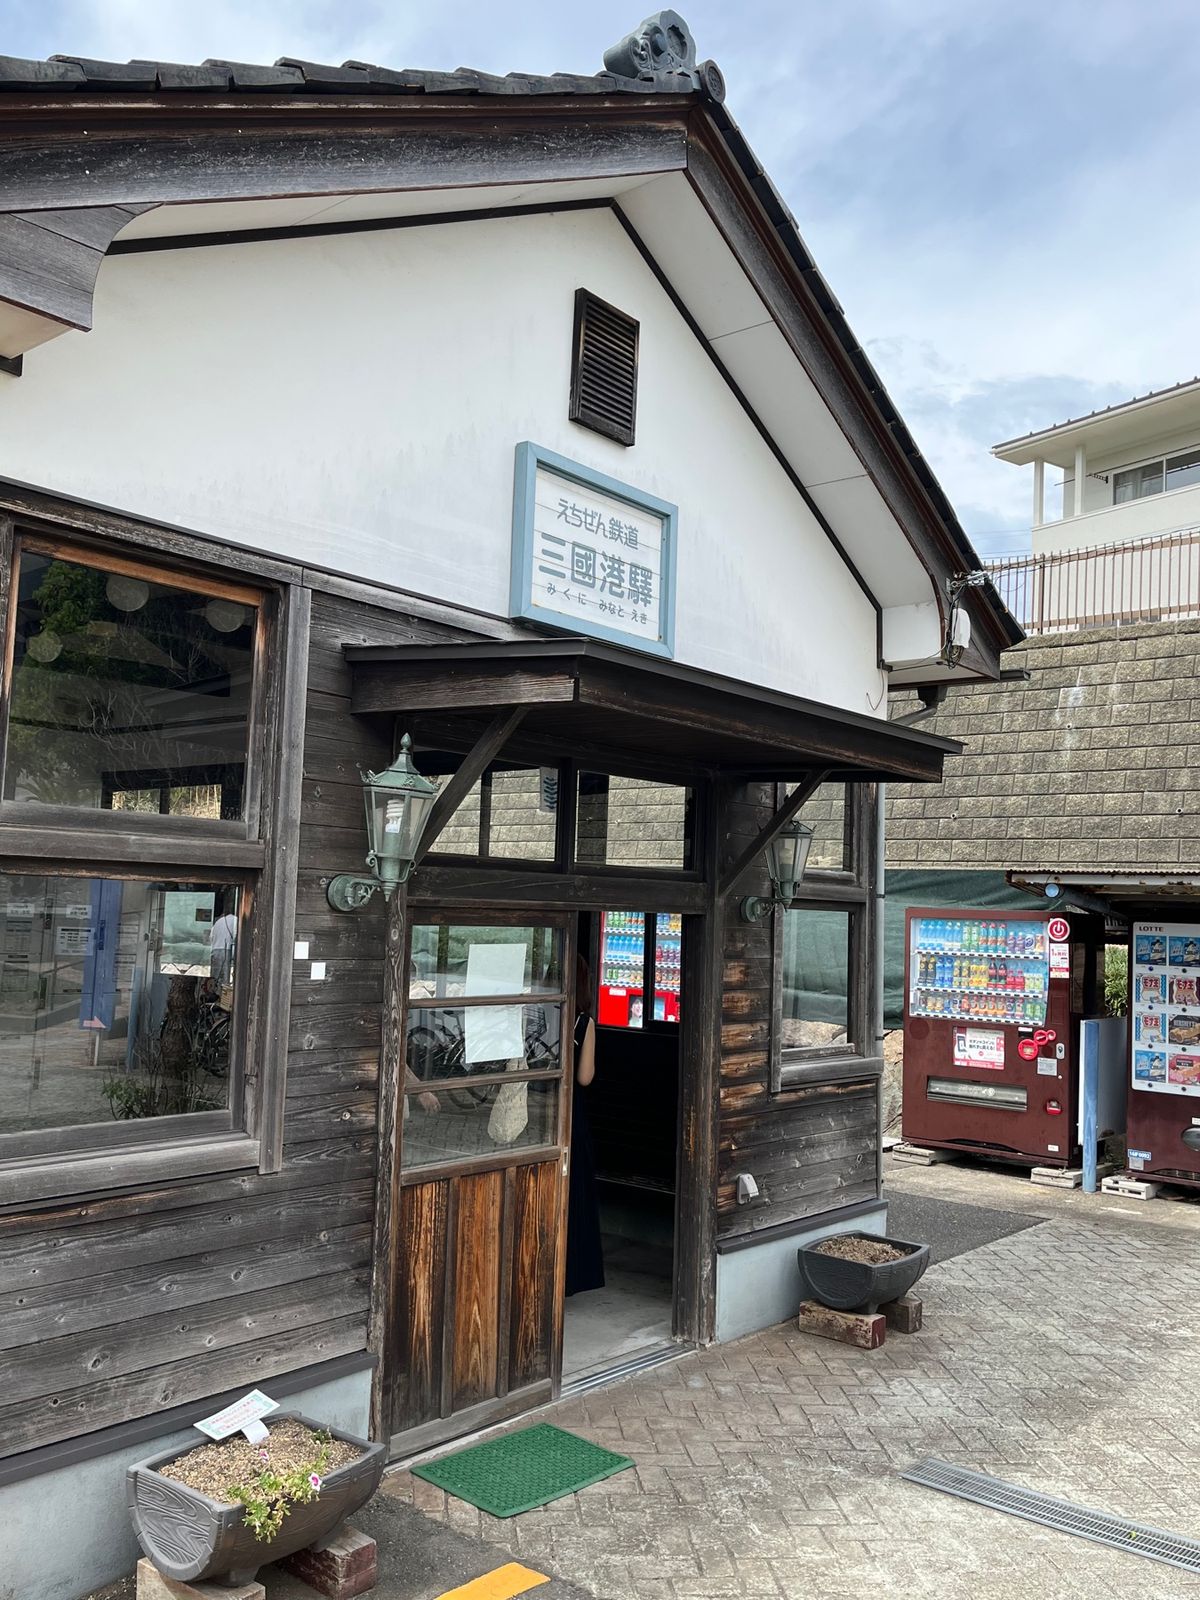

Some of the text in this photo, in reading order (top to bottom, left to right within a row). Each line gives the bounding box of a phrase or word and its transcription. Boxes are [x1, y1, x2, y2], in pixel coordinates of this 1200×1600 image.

[557, 498, 639, 550] えちぜん鉄道
[539, 532, 652, 607] 三國港驛
